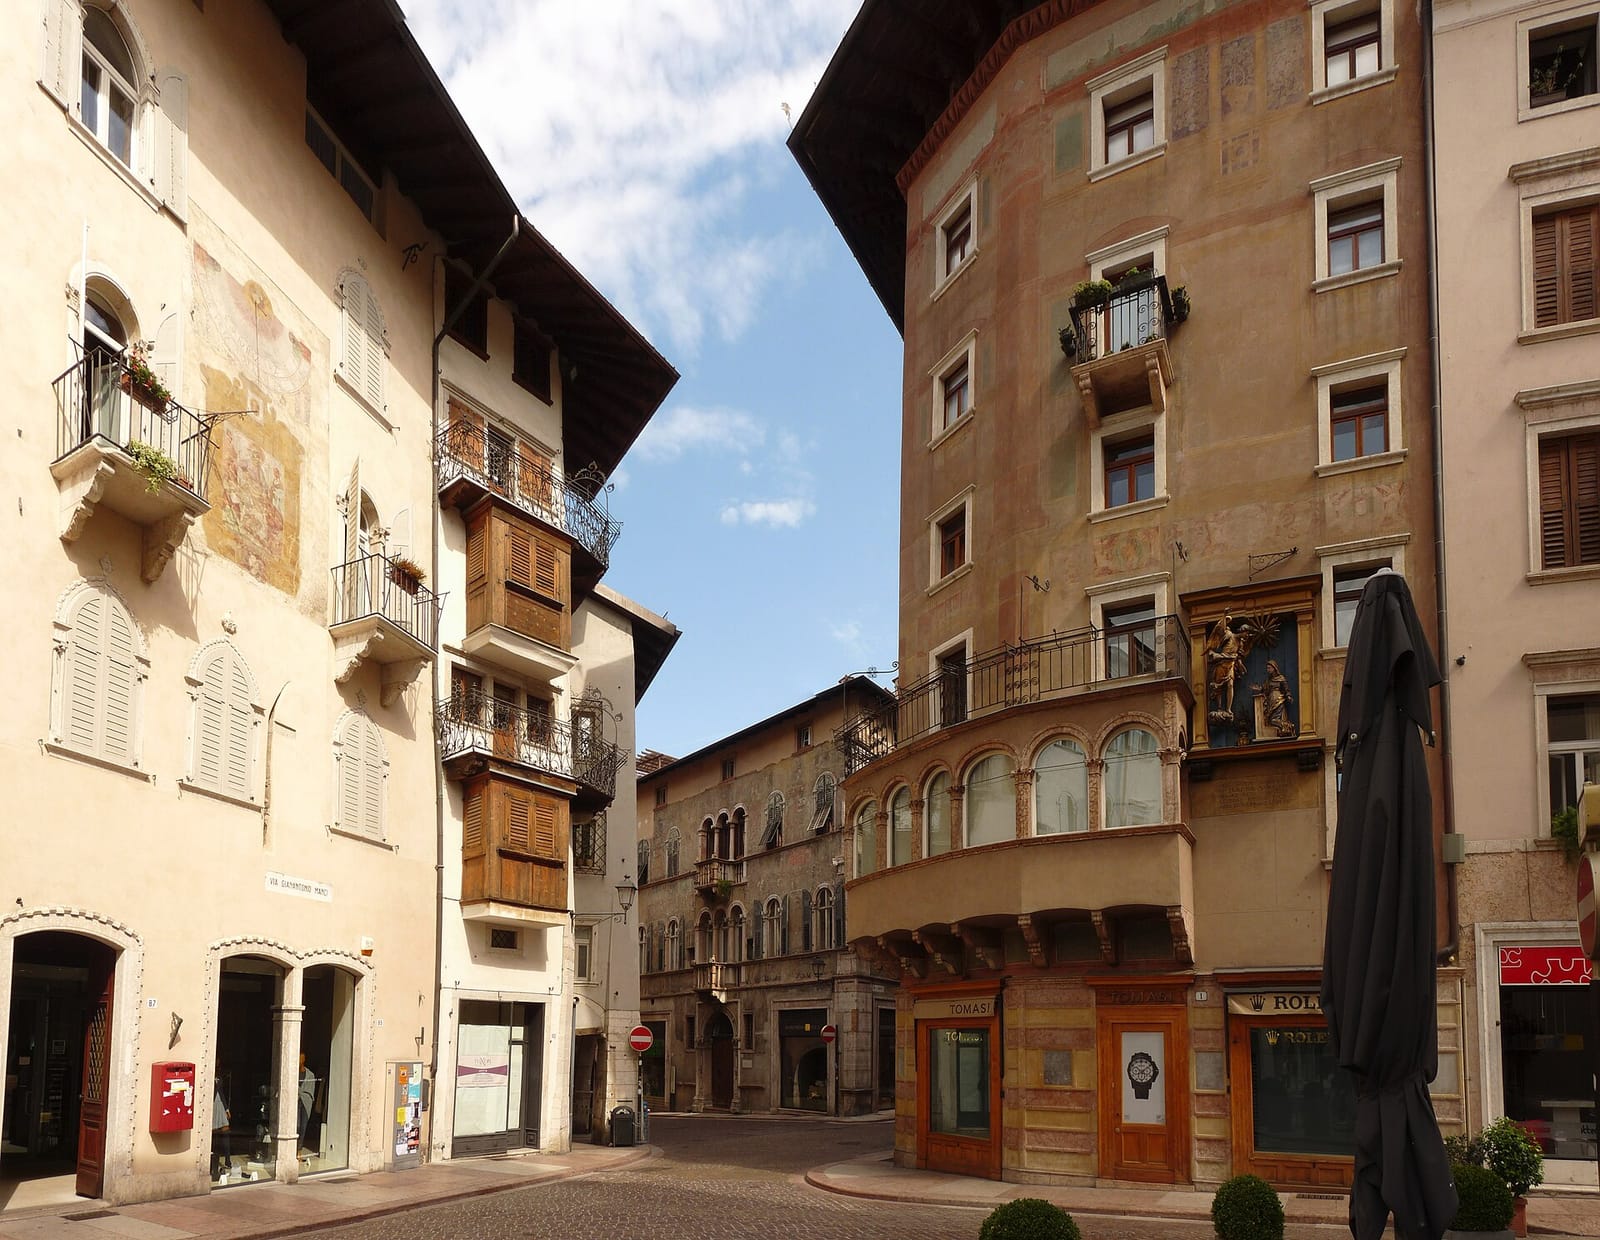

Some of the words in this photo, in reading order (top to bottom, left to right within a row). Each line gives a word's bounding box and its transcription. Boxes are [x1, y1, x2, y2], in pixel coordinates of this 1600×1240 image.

[269, 877, 278, 886] VIA
[949, 1002, 990, 1015] TOMASI
[1284, 1031, 1331, 1044] ROLE
